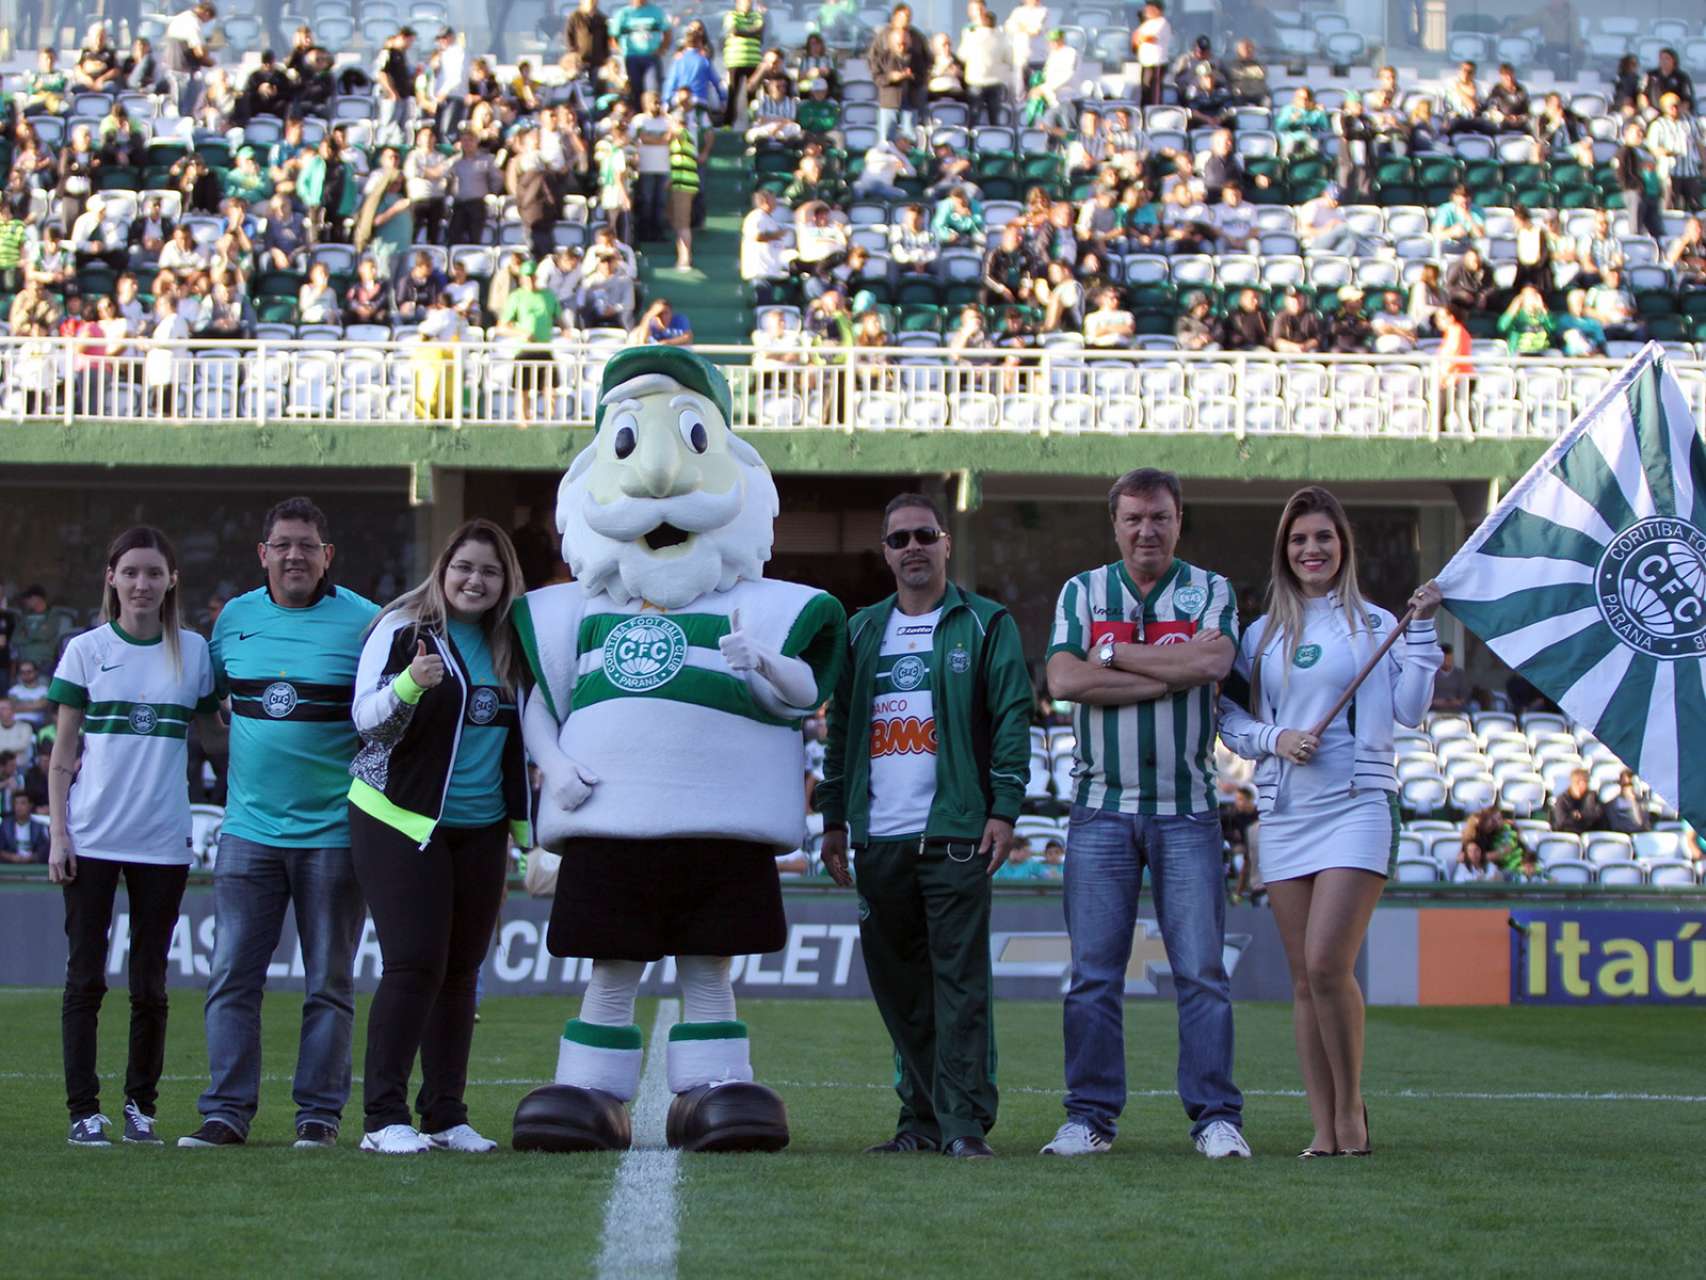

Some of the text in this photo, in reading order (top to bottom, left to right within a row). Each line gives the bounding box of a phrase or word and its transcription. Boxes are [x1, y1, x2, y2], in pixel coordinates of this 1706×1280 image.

[1609, 523, 1685, 561] CORITIBA
[1637, 554, 1702, 623] CFC
[605, 625, 629, 673] CORITIBA
[629, 617, 661, 627] FOOT
[668, 645, 685, 672] CLUB
[619, 641, 668, 660] CFC
[1528, 921, 1706, 998] Itaú
